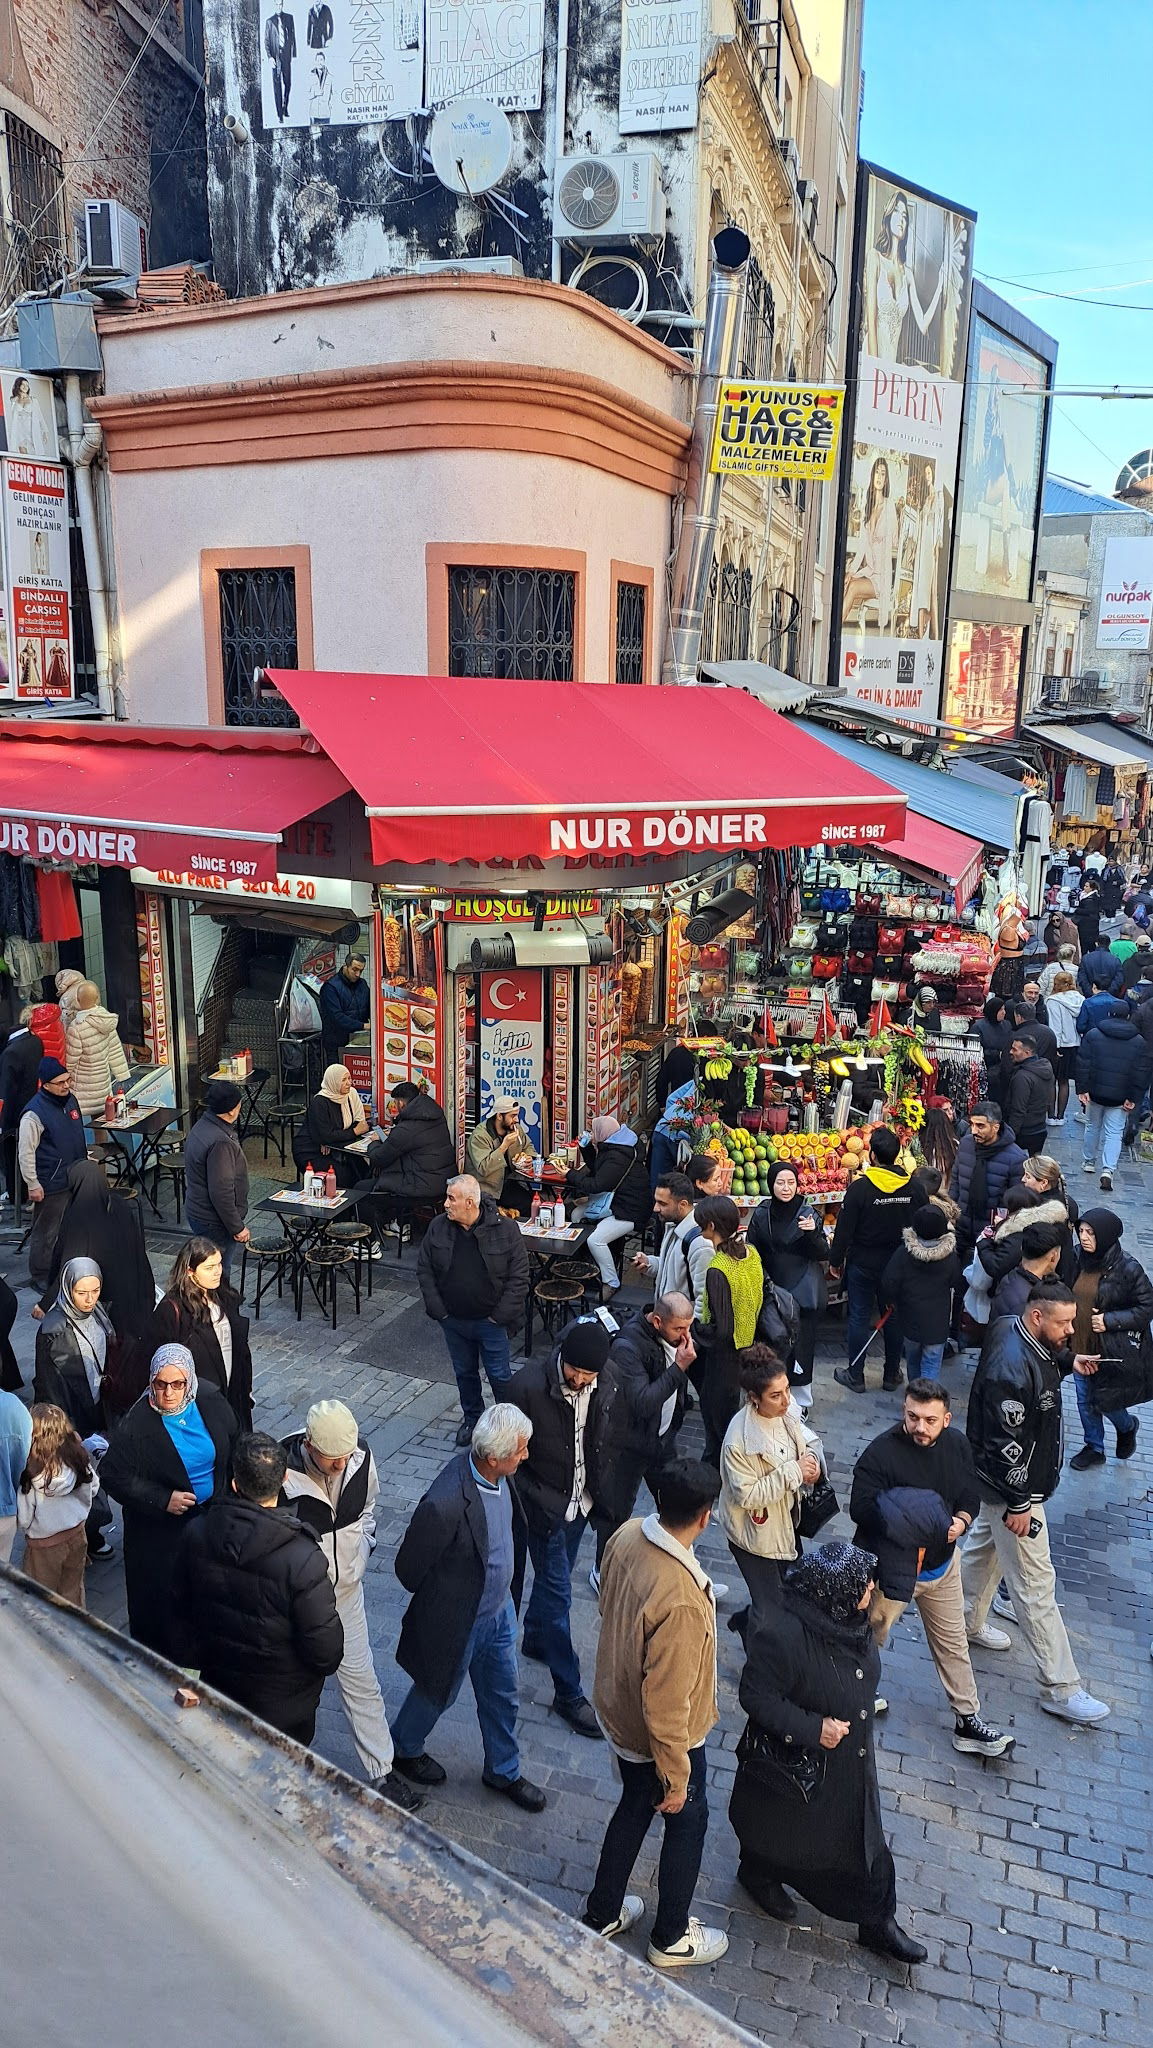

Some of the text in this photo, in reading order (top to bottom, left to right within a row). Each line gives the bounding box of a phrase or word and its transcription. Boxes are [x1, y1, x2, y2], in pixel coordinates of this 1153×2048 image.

[349, 0, 385, 81] AZAR
[430, 3, 541, 64] HACI
[341, 81, 394, 104] GİYİM
[497, 96, 519, 107] KAT
[531, 95, 537, 104] 1
[347, 106, 370, 114] NASIR
[636, 104, 689, 116] NASIR HAN
[747, 389, 813, 407] YUNUS
[723, 405, 833, 430] HAC &
[720, 423, 833, 449] UMRE
[720, 445, 828, 464] MALZEMELERİ
[8, 461, 64, 490] GENÇ MODA
[37, 495, 63, 507] DAMAT
[22, 506, 56, 519] BOHÇASI
[16, 517, 62, 531] HAZIRLANIR
[18, 576, 63, 588] GİRİŞ KATTA
[1105, 590, 1152, 604] nurpak
[44, 687, 62, 696] KATTA
[885, 688, 892, 707] &
[894, 689, 923, 708] DAMAT
[550, 809, 767, 850] NUR DÖNER
[860, 824, 886, 838] 1987
[37, 822, 137, 864] DÖNER
[229, 860, 257, 876] 1987
[296, 880, 316, 900] 20
[352, 1059, 370, 1067] KREDİ
[492, 1057, 534, 1068] Hayata
[352, 1069, 370, 1077] KARTI
[496, 1066, 530, 1079] dolu
[493, 1079, 537, 1088] tarafından
[503, 1086, 526, 1098] bak
